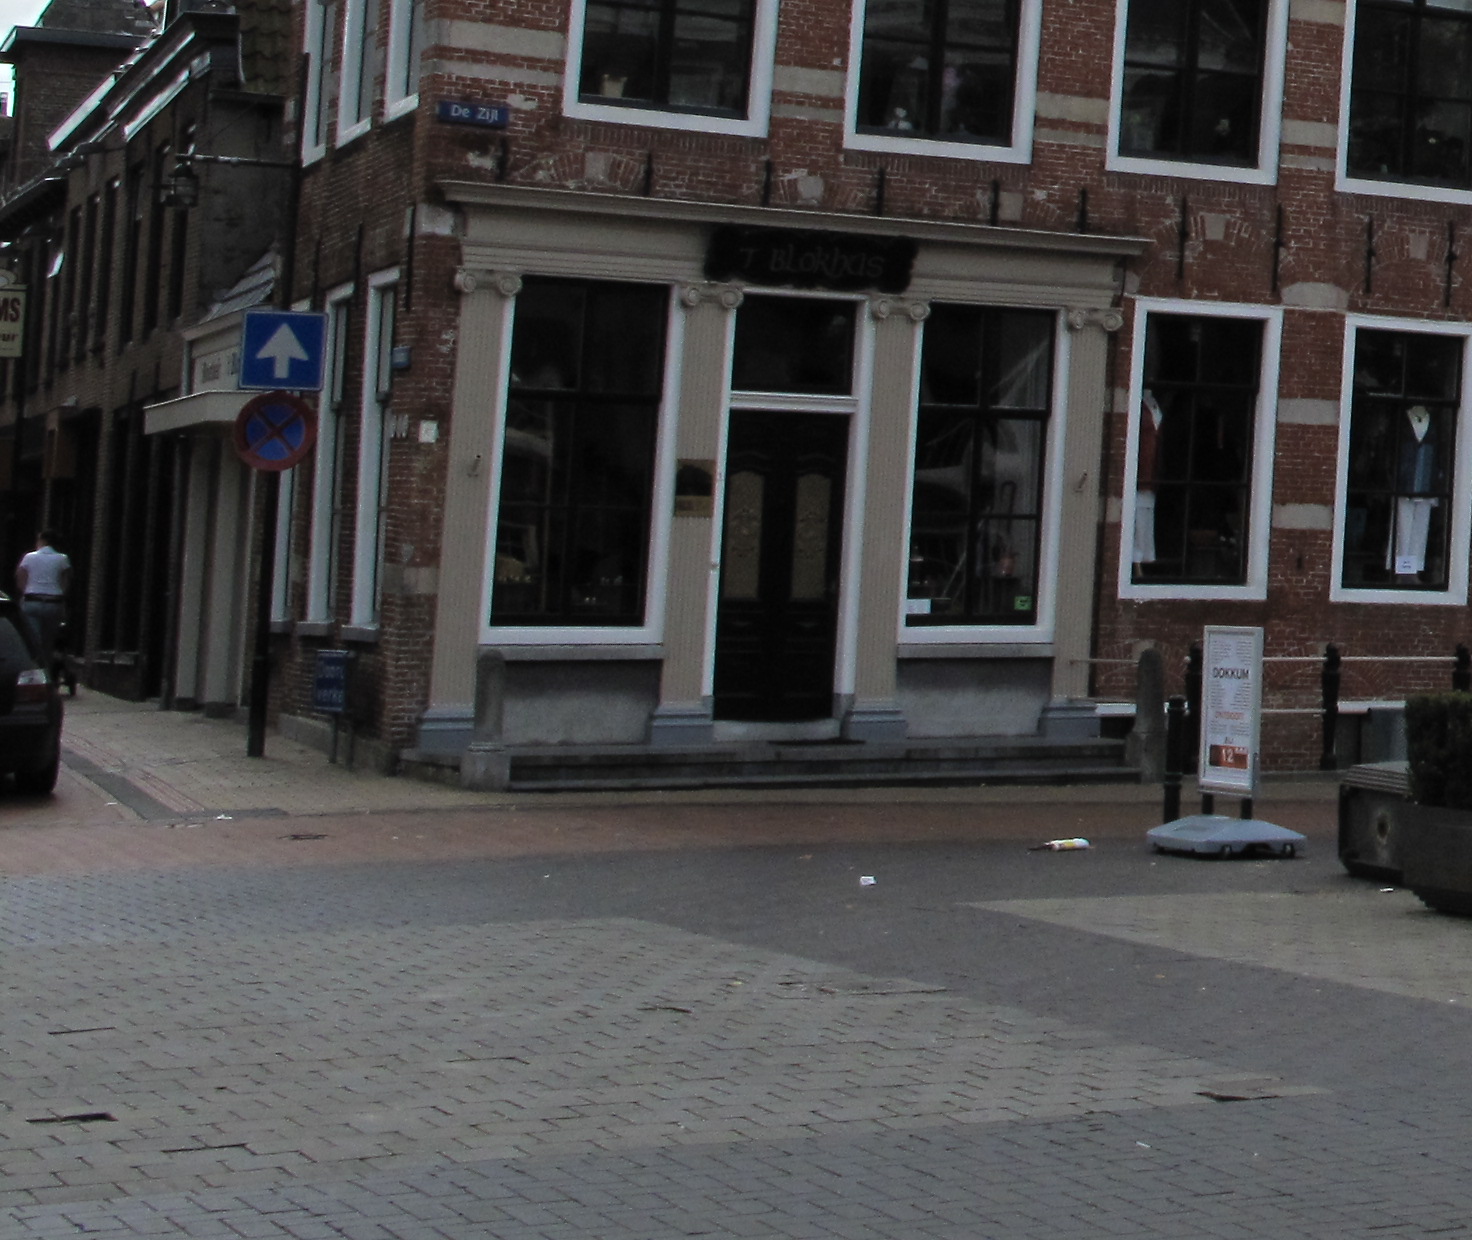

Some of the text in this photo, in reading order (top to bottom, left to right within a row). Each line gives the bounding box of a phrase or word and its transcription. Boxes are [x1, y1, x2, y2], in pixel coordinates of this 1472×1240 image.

[450, 104, 499, 123] De Zijl
[1212, 666, 1249, 680] DOKKUM
[1222, 748, 1234, 763] 12
